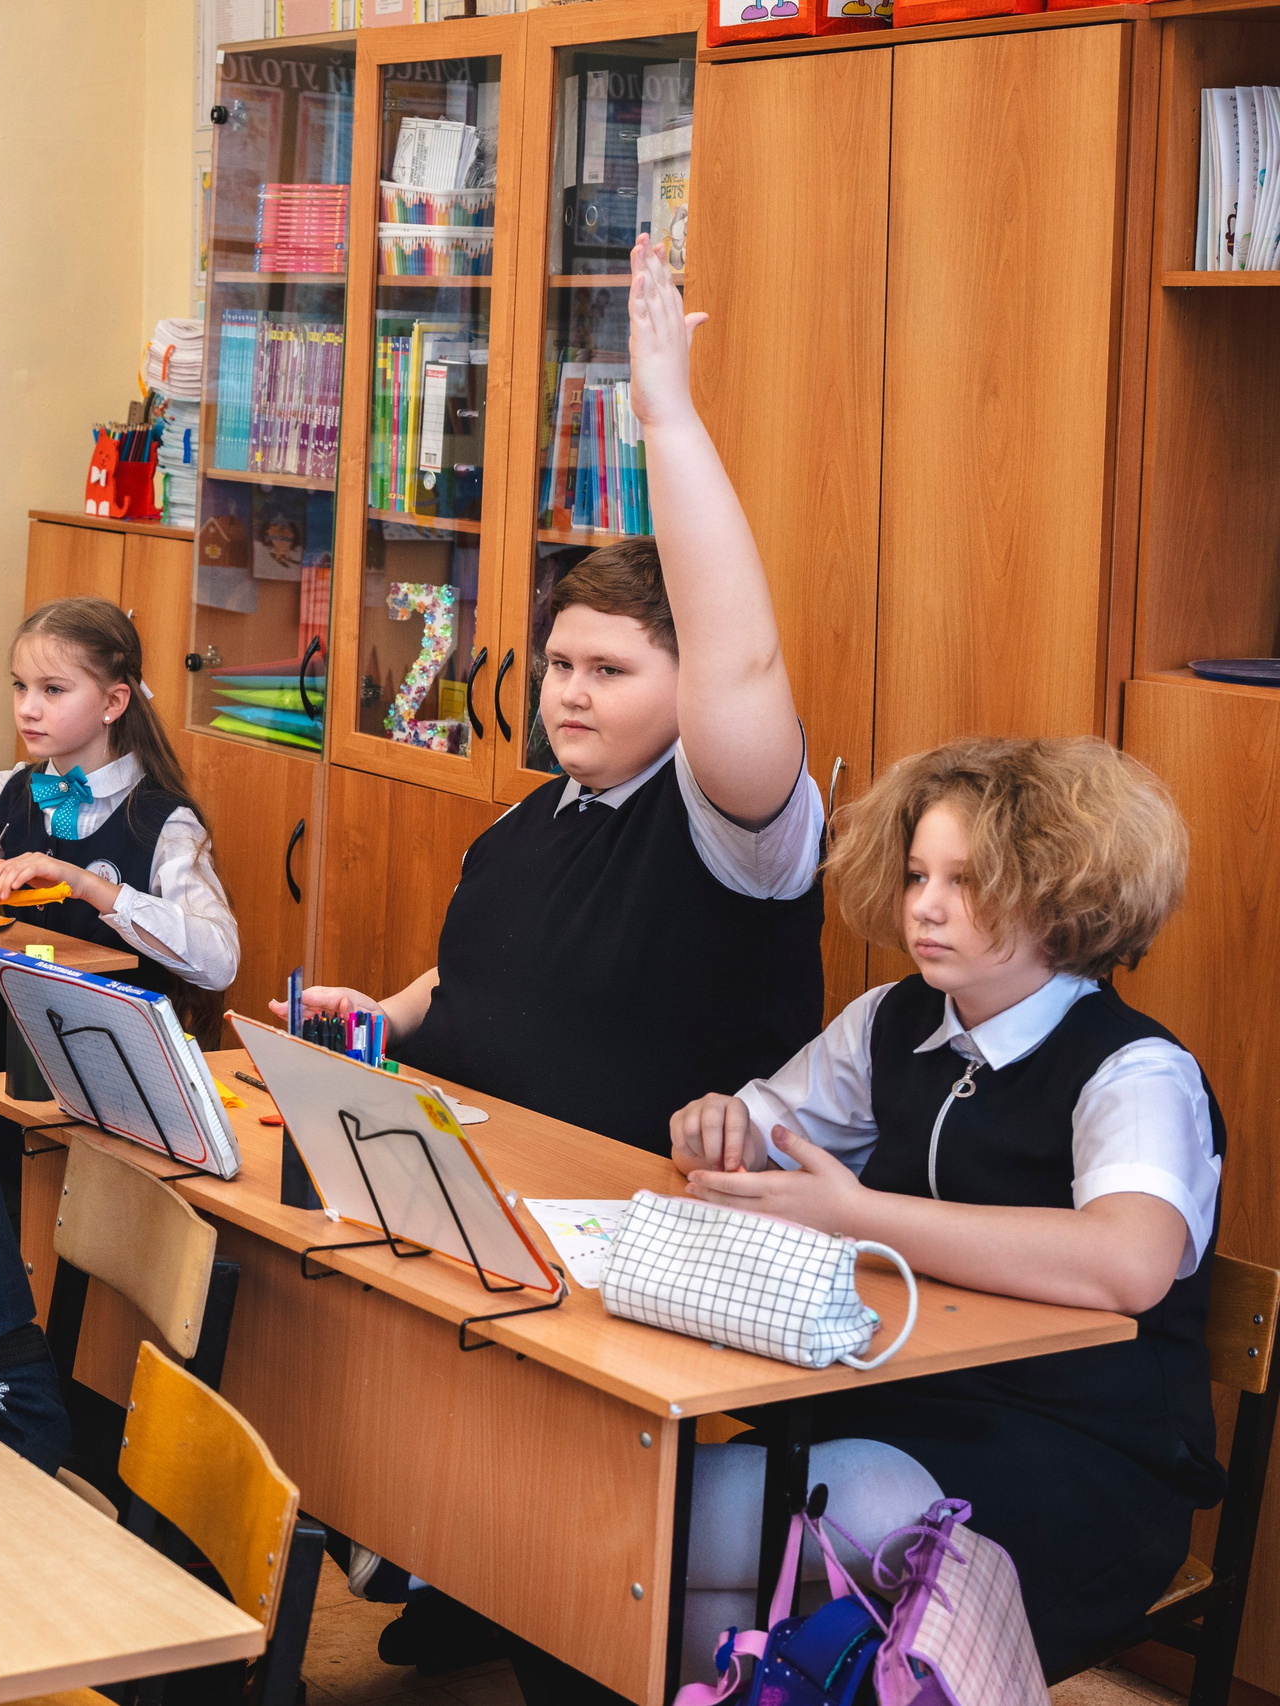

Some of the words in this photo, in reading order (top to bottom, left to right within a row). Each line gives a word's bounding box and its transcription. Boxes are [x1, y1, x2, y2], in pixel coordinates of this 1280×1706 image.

[660, 172, 686, 184] LOVELY
[660, 185, 684, 200] PETS
[385, 582, 469, 758] 2
